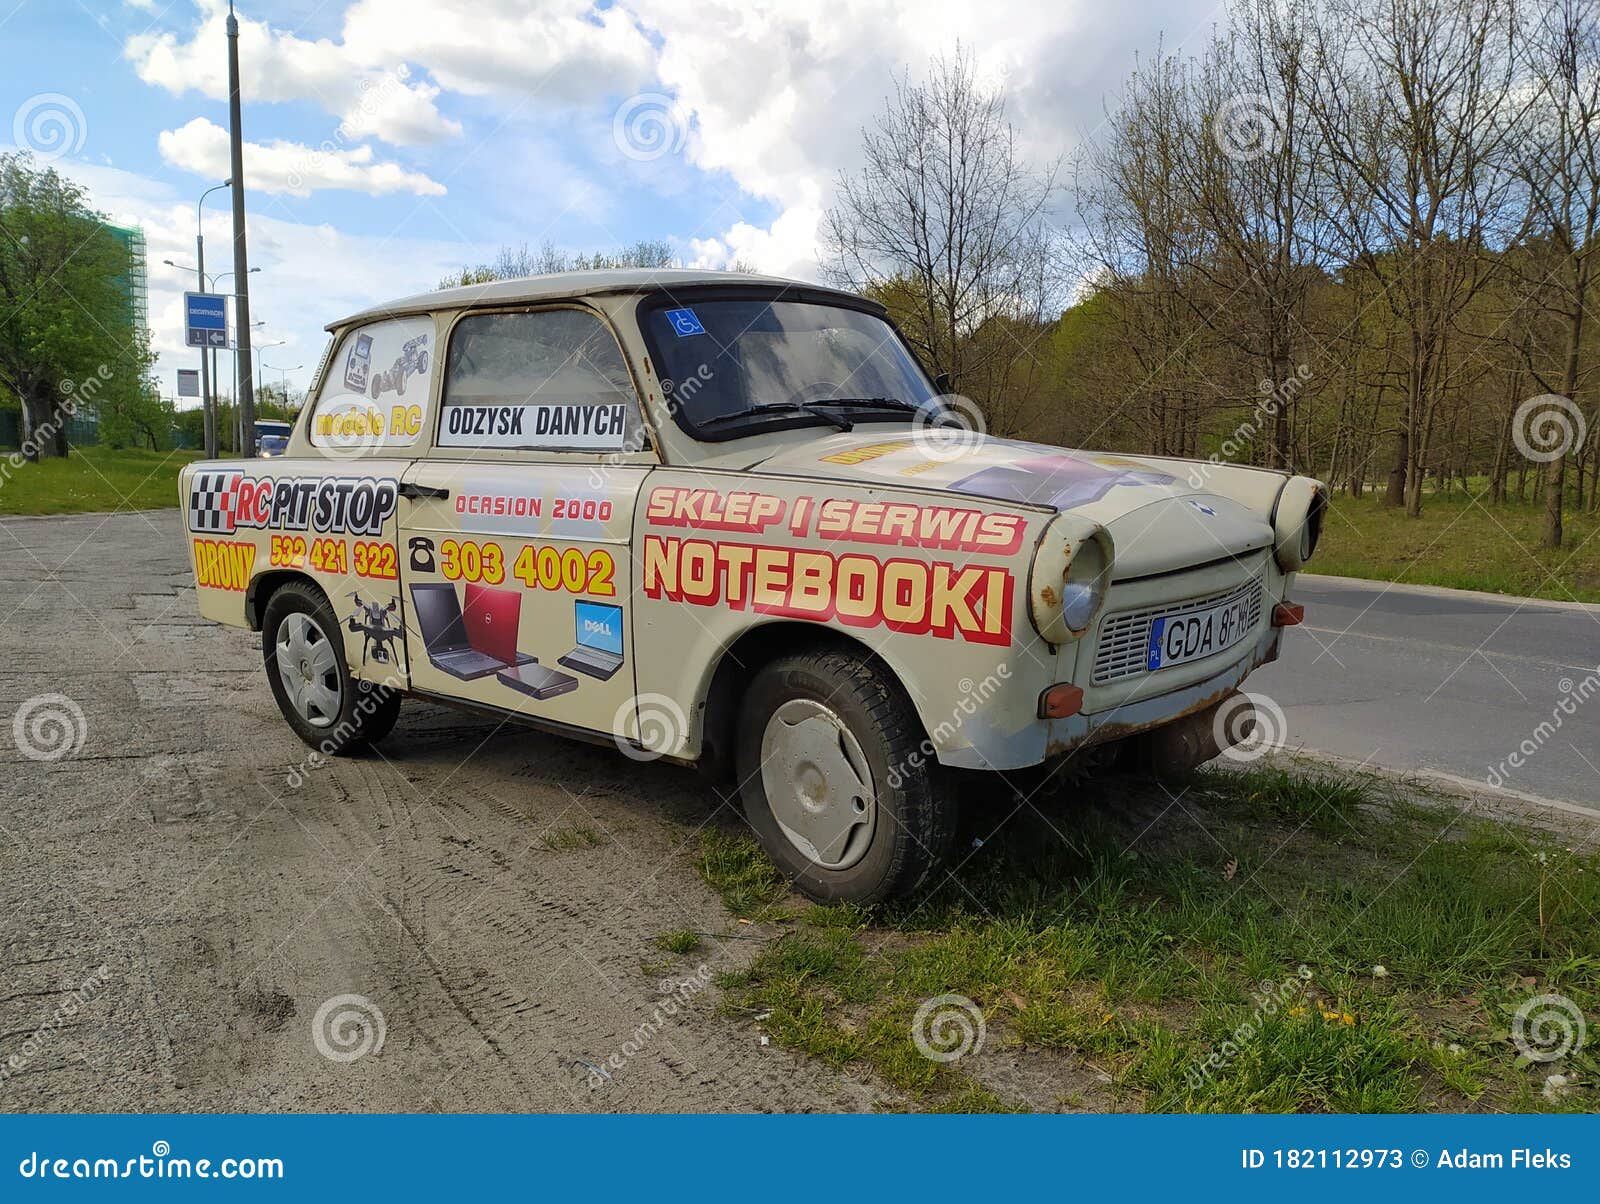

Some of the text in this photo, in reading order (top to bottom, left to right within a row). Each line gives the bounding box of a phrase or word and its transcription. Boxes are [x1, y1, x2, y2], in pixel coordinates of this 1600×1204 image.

[390, 404, 422, 436] RC
[448, 405, 623, 436] ODZYSK DANYCH
[456, 495, 612, 521] OCASION 2000
[646, 486, 1028, 557] SKLEP I SERWIS
[193, 538, 256, 592] DRONY
[270, 535, 399, 580] 532 421 322
[440, 538, 616, 597] 303 4002
[643, 534, 1016, 648] NOTEBOOKI
[584, 618, 612, 637] DELL
[1166, 614, 1213, 661] GDA
[1150, 649, 1160, 660] PL
